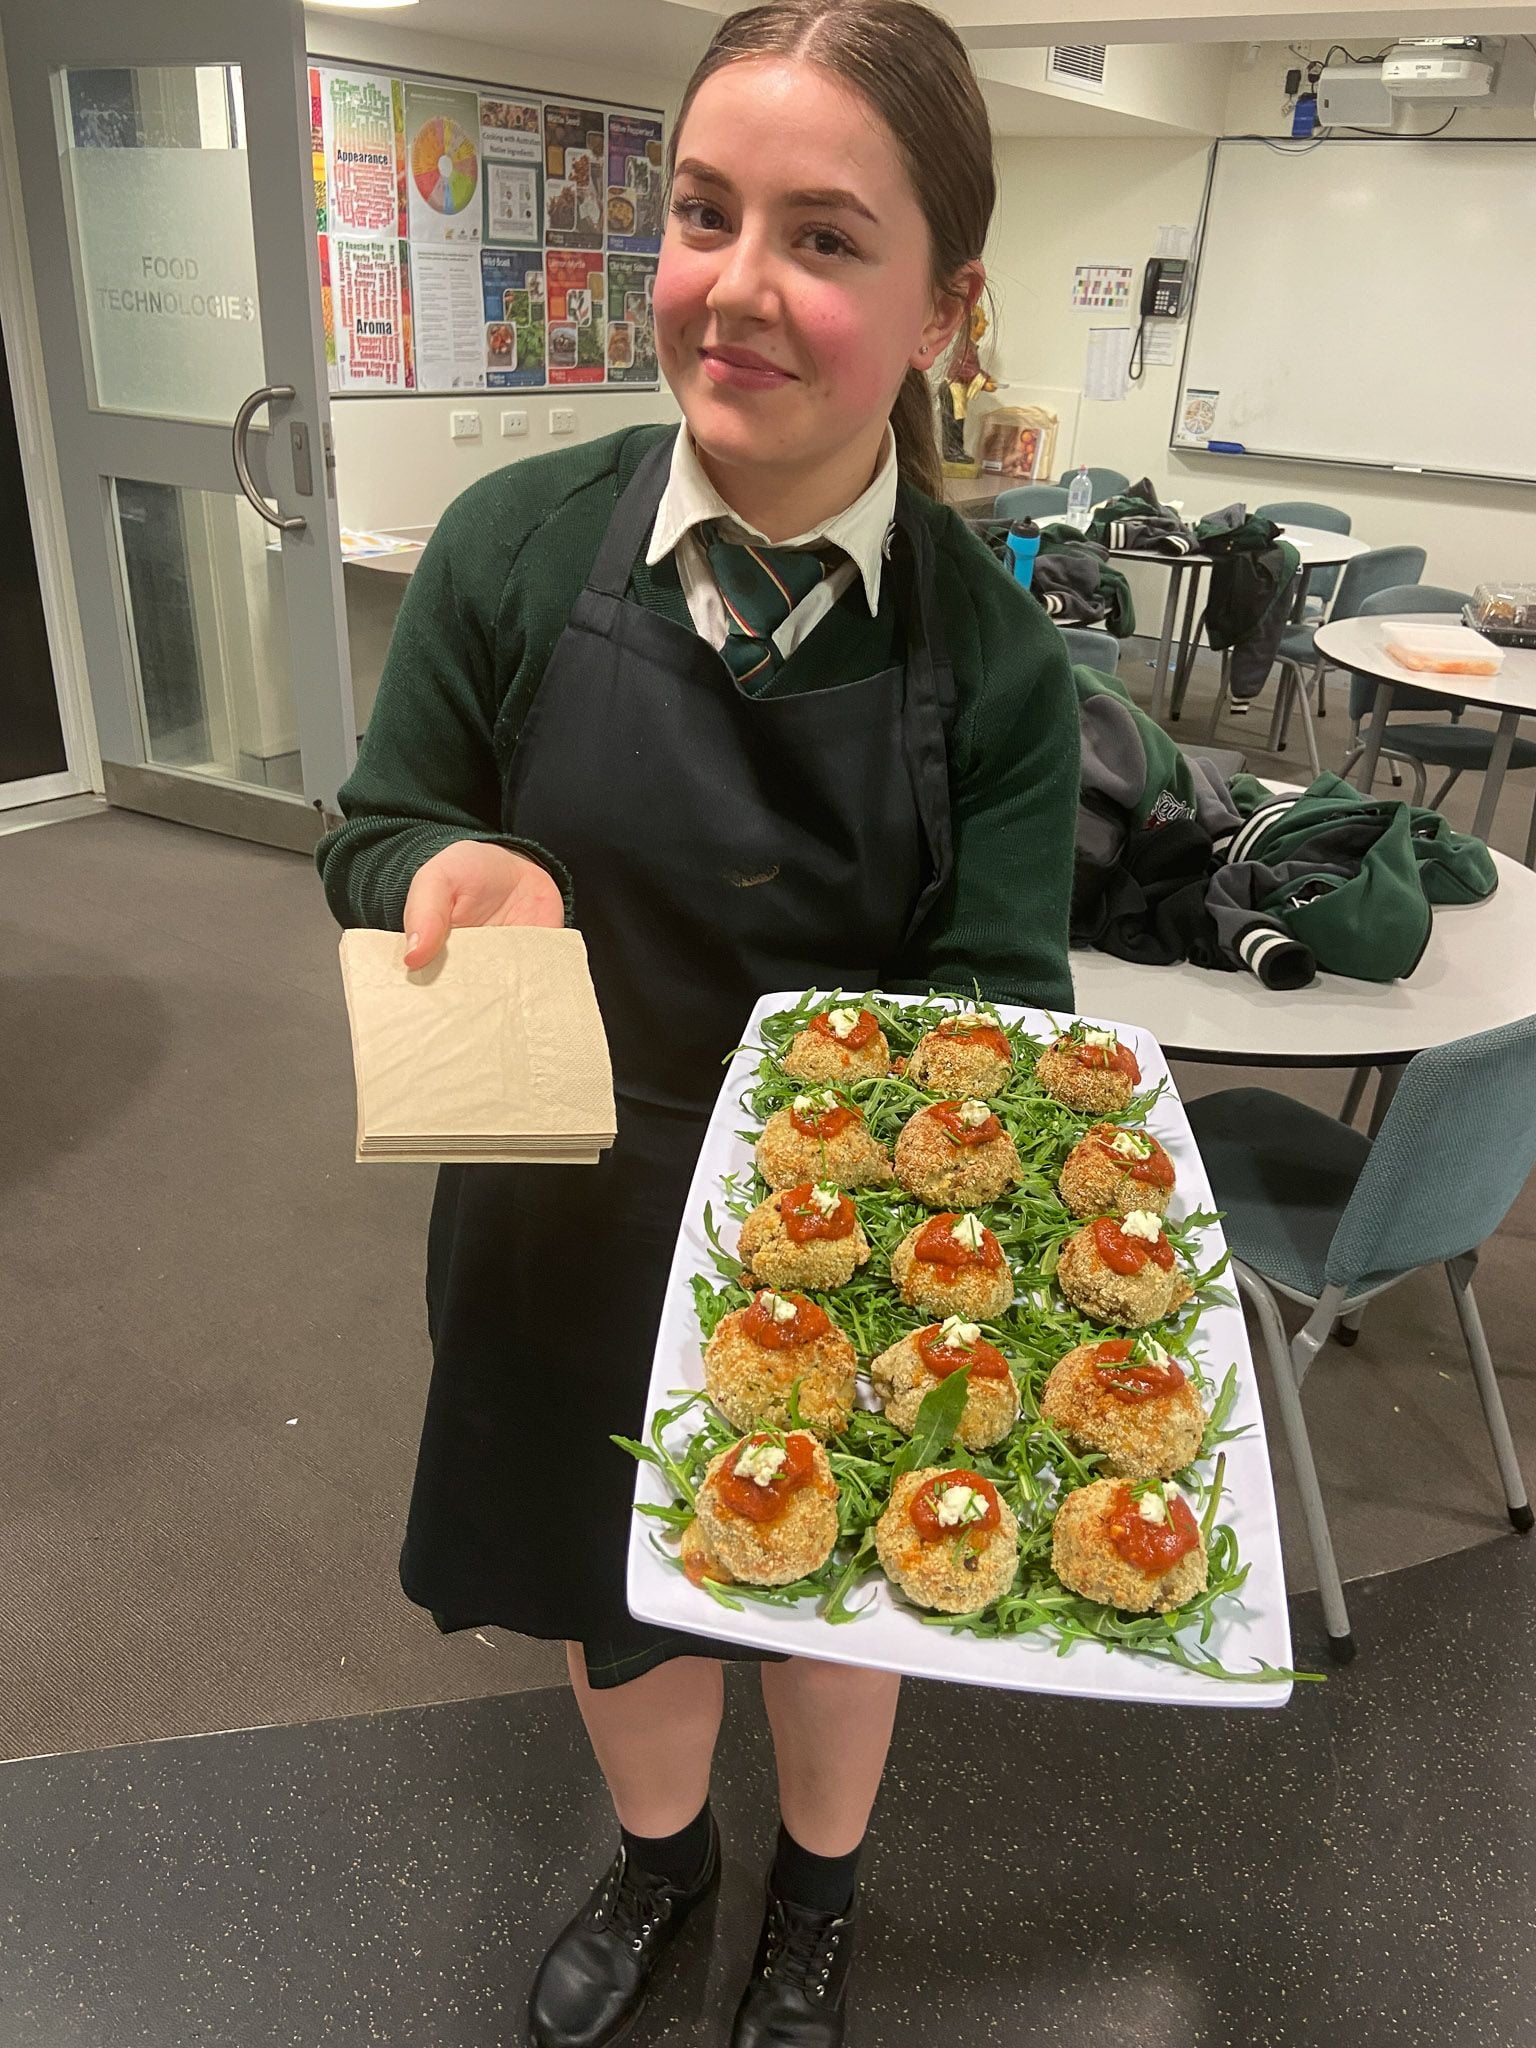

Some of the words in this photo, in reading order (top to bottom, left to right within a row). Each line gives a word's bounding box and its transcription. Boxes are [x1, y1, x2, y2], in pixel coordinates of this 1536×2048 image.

[337, 149, 389, 165] Appearance
[141, 255, 199, 281] FOOD
[95, 287, 256, 322] TECHNOLOGIES
[356, 318, 392, 335] Aroma
